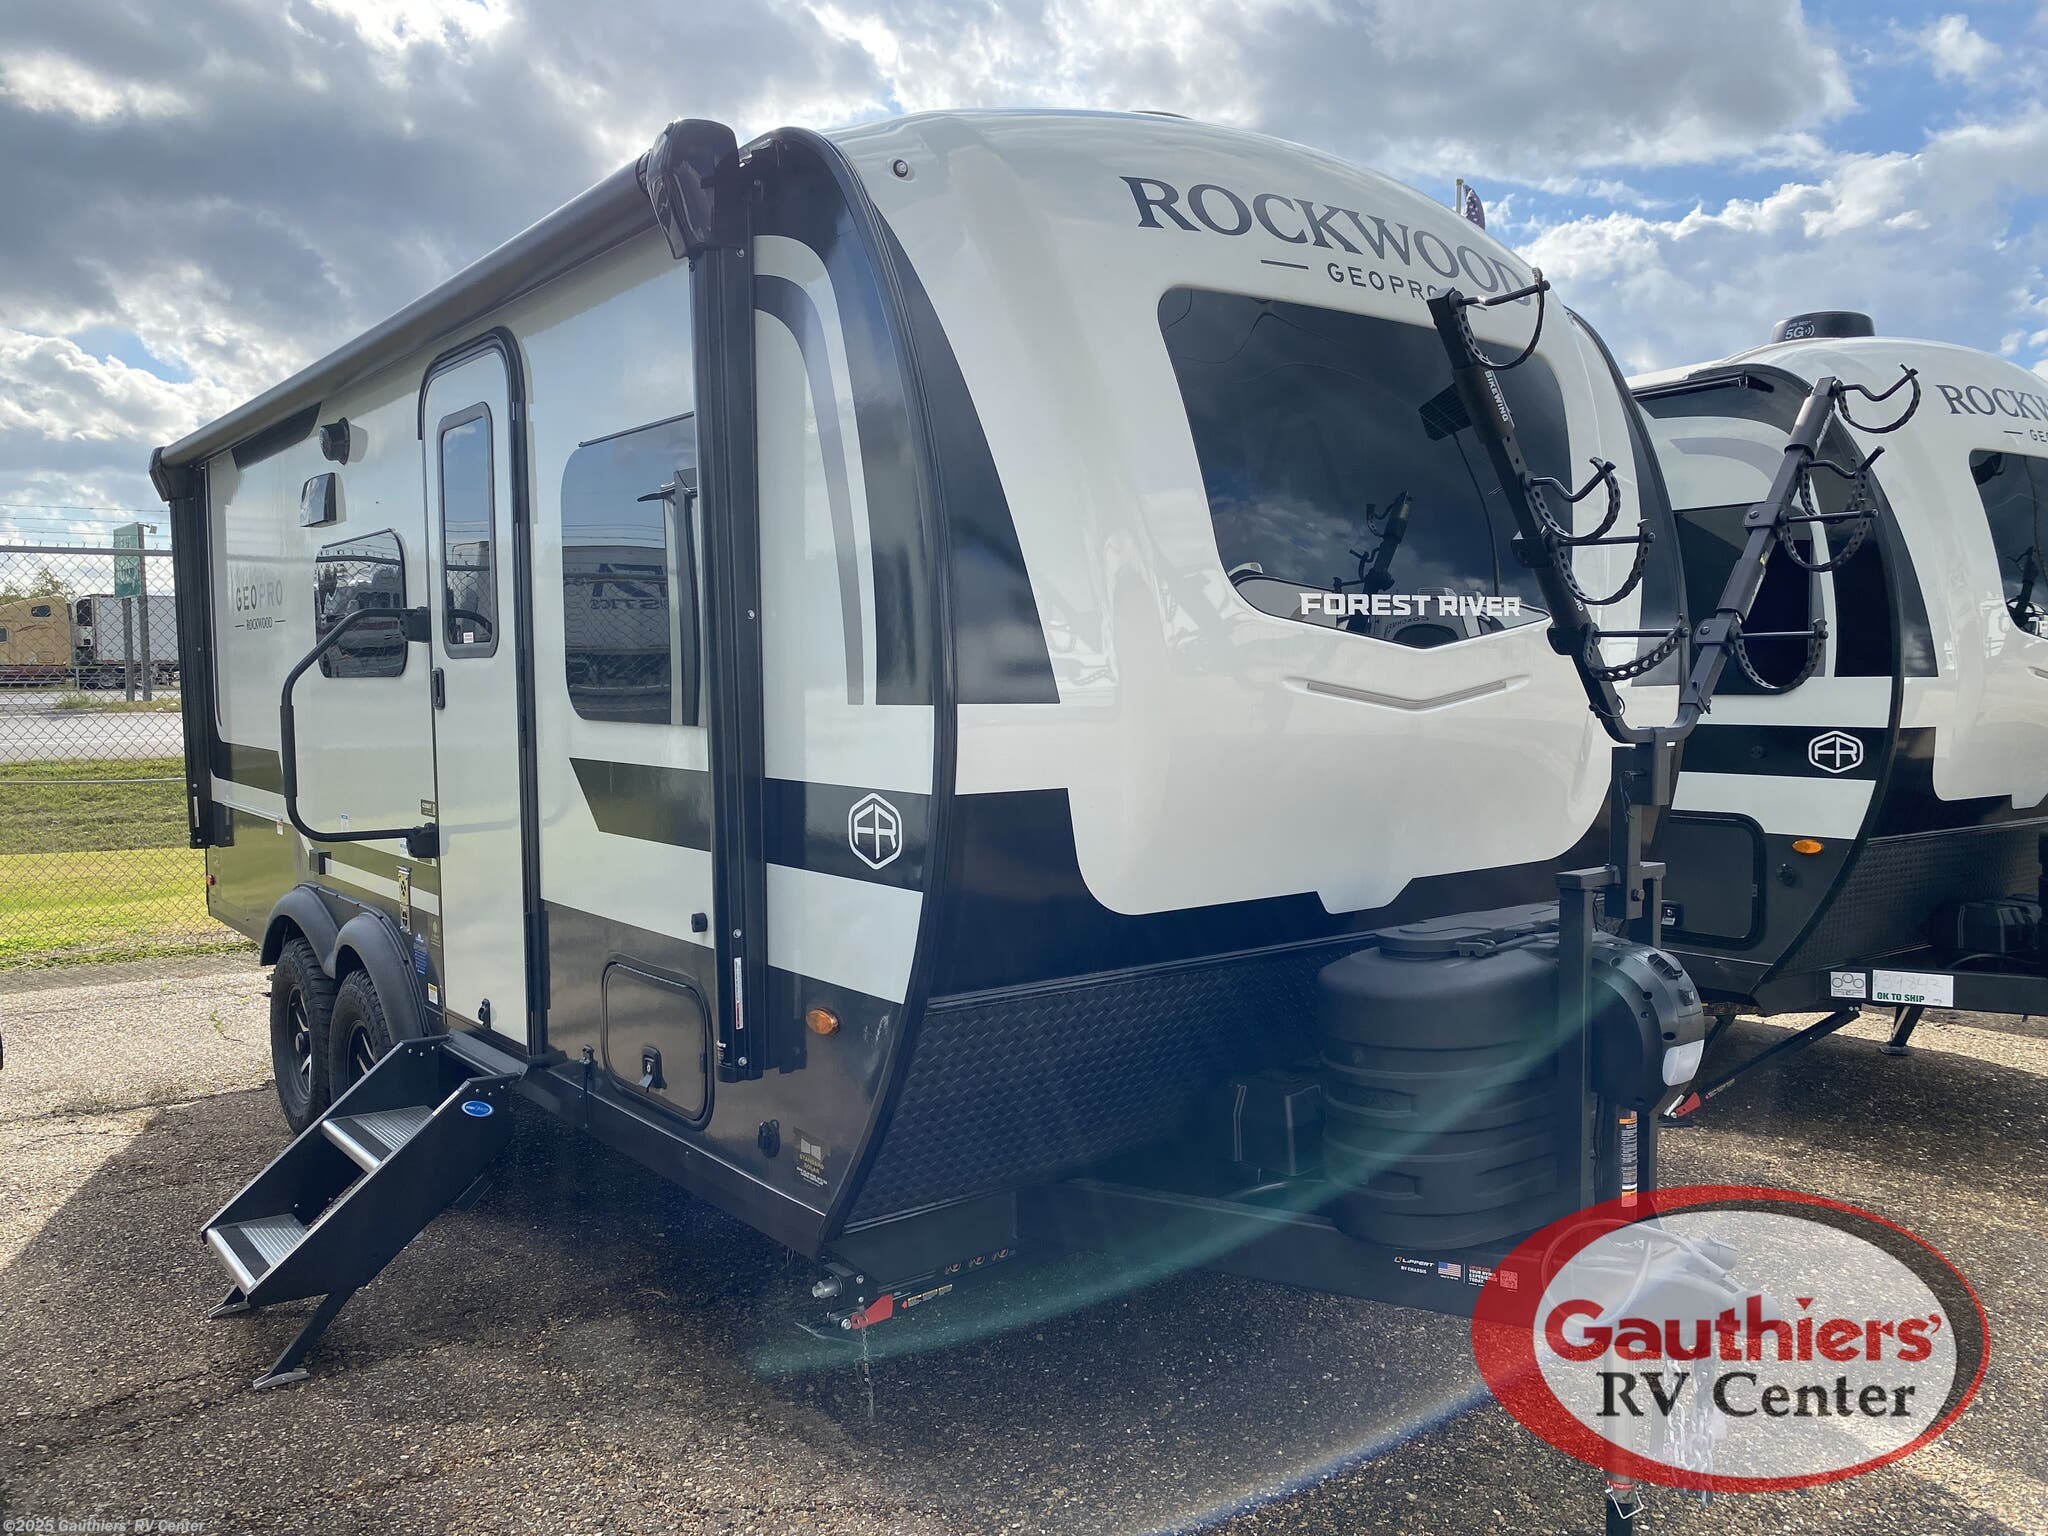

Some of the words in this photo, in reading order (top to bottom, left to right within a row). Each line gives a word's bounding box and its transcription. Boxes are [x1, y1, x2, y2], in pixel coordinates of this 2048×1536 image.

[1119, 176, 1531, 306] ROCKWOOD
[1785, 327, 1804, 340] 5G
[1484, 370, 1510, 422] BIKEWING
[236, 580, 283, 611] GEOPRO
[1300, 593, 1431, 616] FOREST
[1437, 595, 1521, 617] RIVER
[246, 616, 273, 630] ROCKWOOD
[1877, 992, 1889, 1000] OK
[1891, 993, 1902, 1001] TO
[1904, 994, 1925, 1003] SHIP
